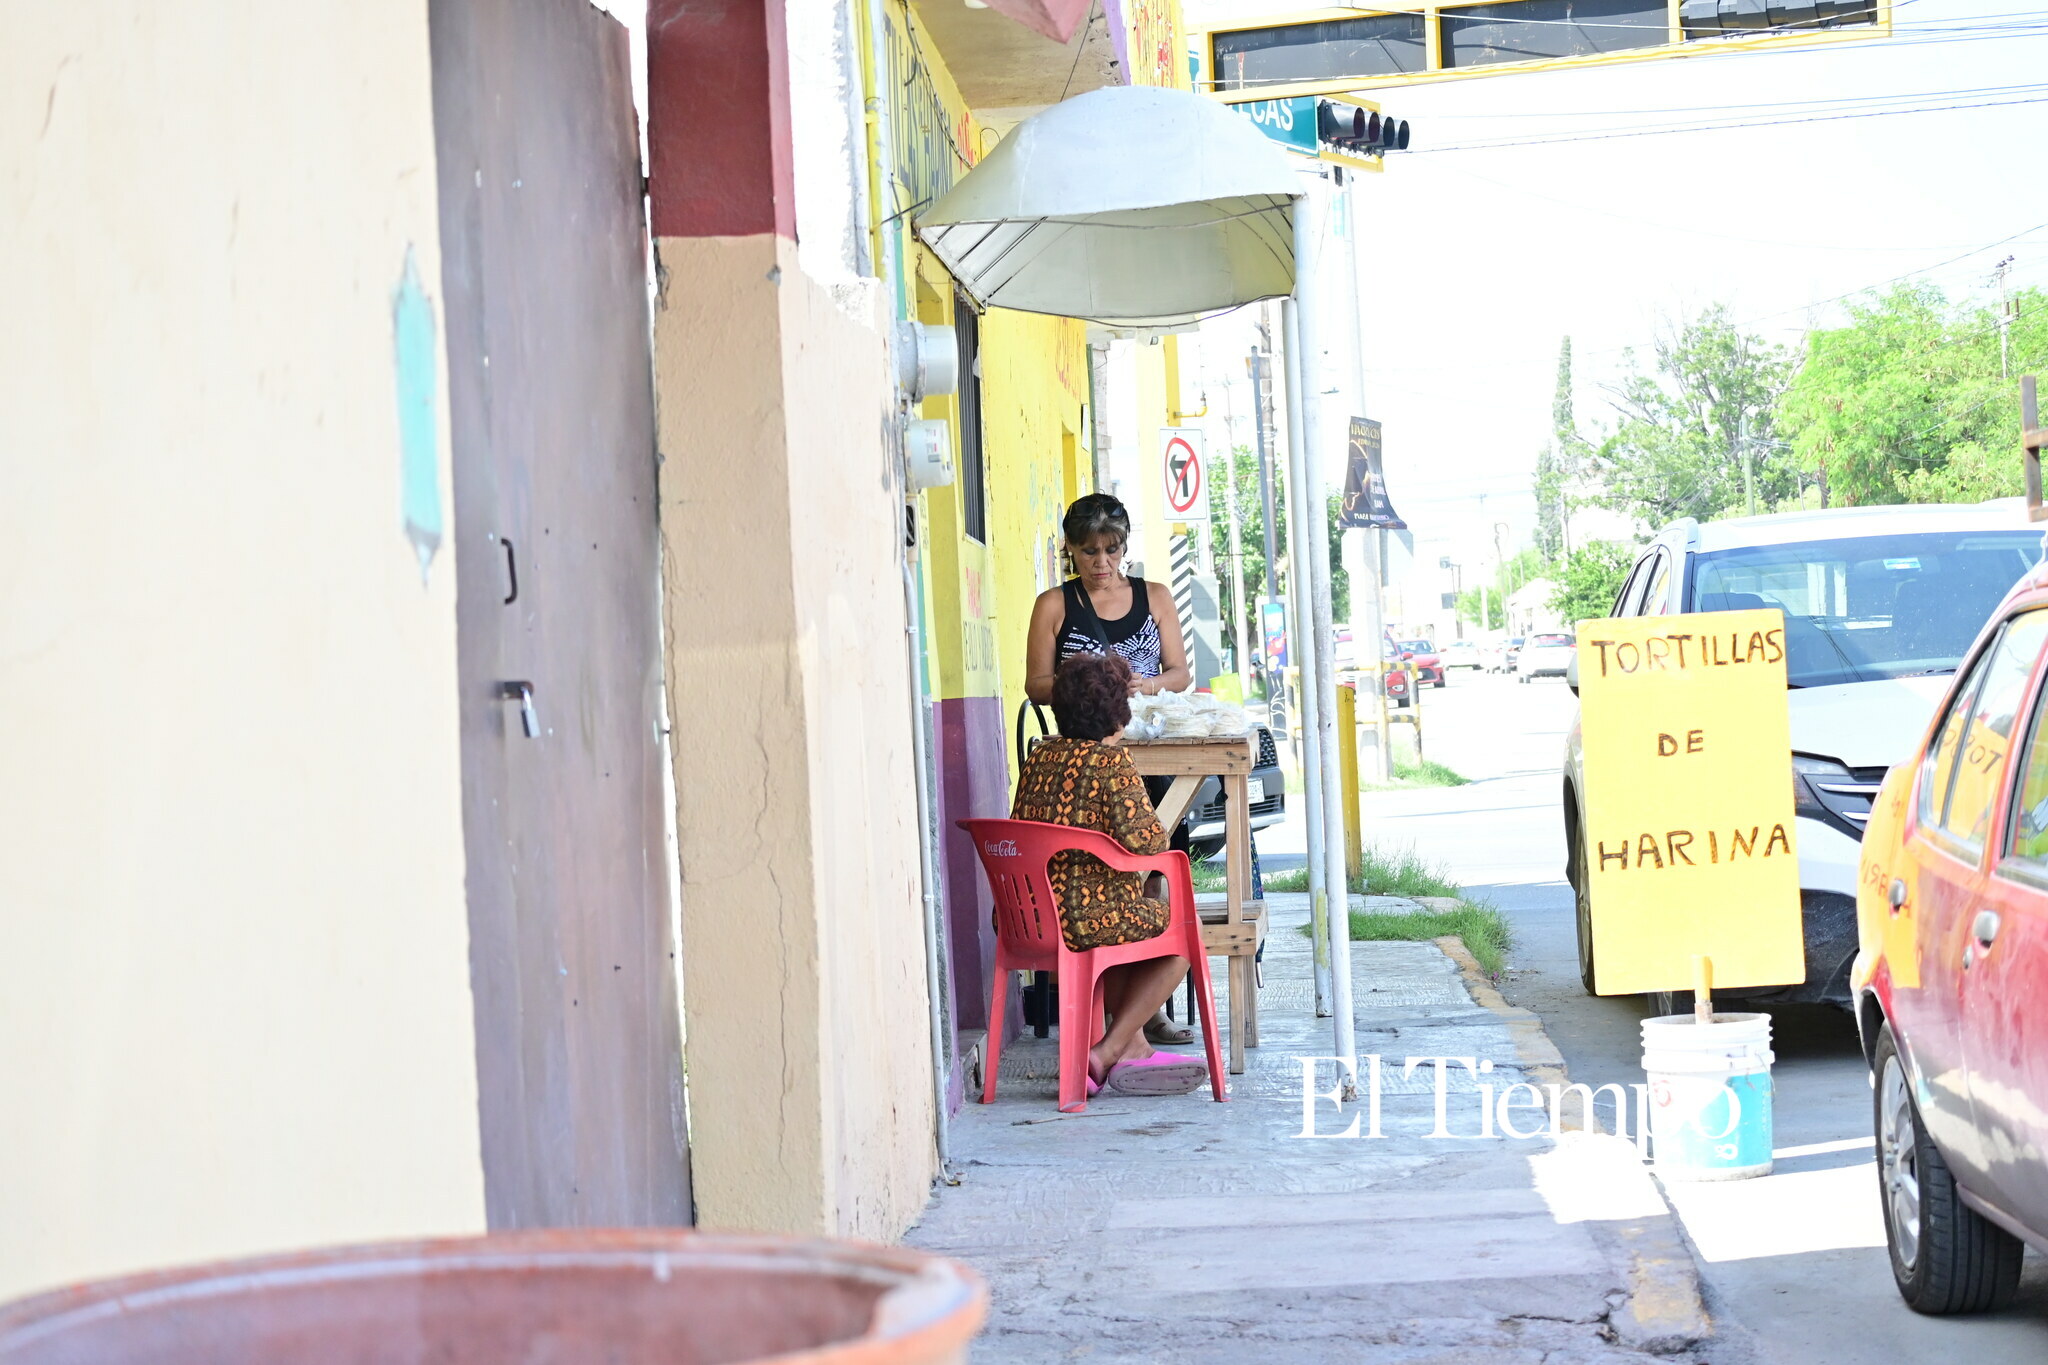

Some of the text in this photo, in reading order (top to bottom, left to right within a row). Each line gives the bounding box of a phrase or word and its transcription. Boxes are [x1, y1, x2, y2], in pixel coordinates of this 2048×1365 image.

[1591, 628, 1783, 678] TORTILLAS
[1657, 729, 1704, 757] DE
[1598, 823, 1792, 872] HARINA
